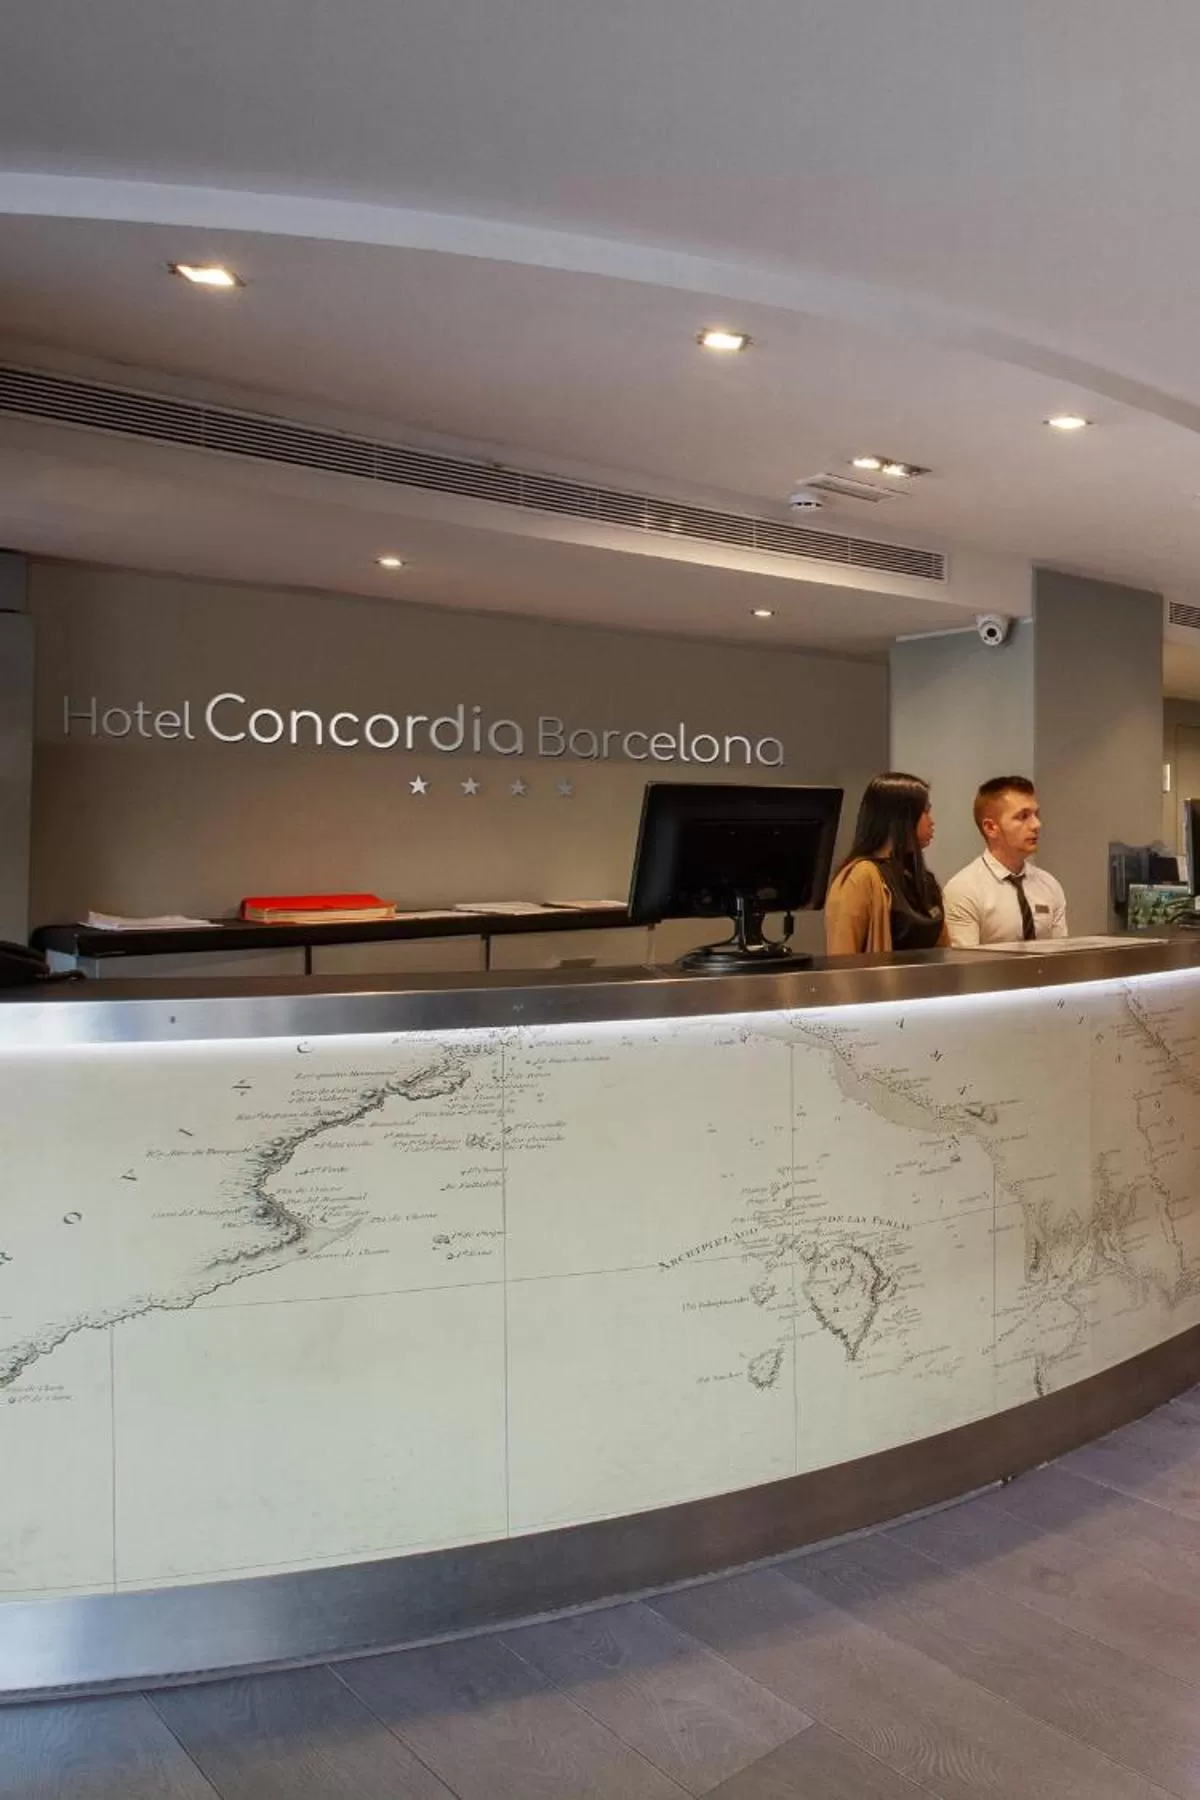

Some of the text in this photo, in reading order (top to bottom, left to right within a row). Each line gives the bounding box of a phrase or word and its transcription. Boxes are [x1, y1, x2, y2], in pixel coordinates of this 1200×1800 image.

[63, 692, 785, 767] Hotel Concordia Barcelona
